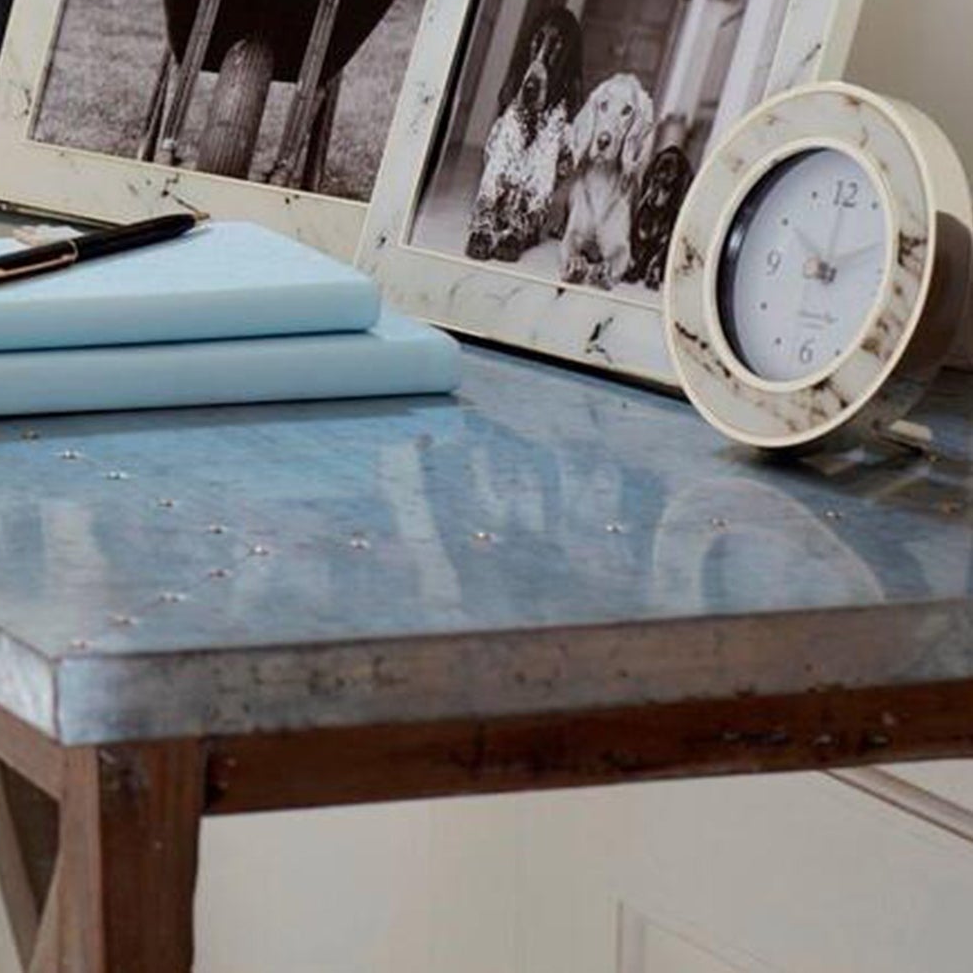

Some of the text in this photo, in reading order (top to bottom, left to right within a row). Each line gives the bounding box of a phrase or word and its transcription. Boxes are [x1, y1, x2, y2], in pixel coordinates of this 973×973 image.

[832, 180, 859, 208] 12
[766, 249, 782, 276] 9
[799, 337, 815, 364] 6
